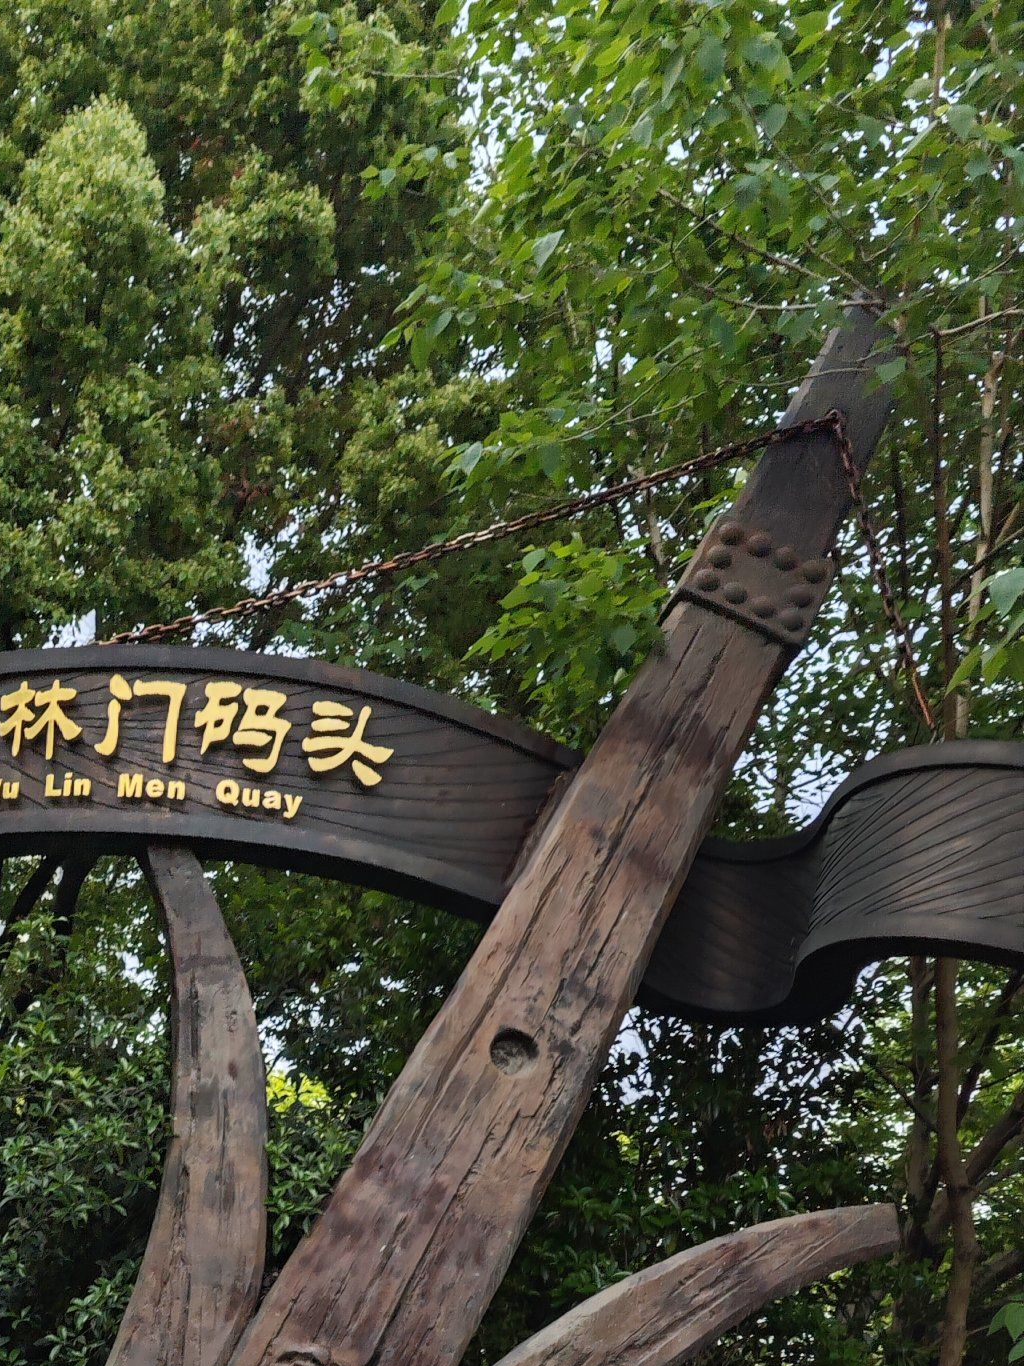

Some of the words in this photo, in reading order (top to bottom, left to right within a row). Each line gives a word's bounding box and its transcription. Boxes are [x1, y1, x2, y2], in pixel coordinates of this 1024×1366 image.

[44, 772, 92, 797] Lin
[117, 773, 186, 800] Men
[215, 779, 303, 819] Quay
